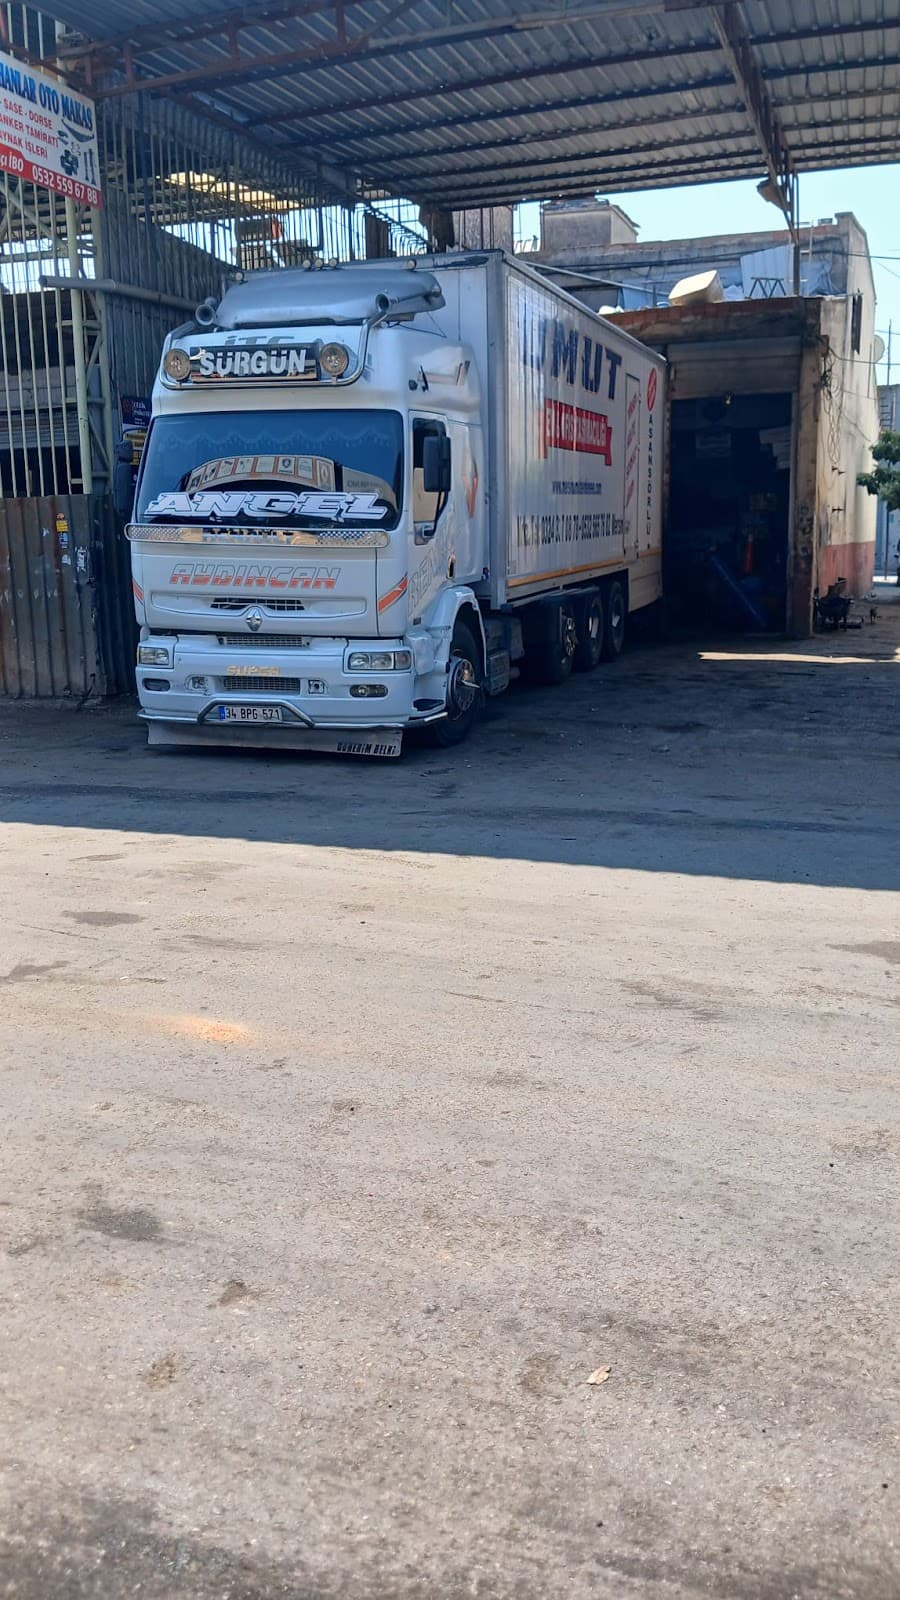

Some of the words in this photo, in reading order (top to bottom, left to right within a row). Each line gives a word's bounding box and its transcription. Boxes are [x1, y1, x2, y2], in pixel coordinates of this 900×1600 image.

[29, 109, 53, 130] DORSE
[39, 82, 59, 115] OTO
[61, 93, 93, 131] MAKAS
[32, 165, 54, 187] 0532
[56, 175, 73, 195] 559
[75, 184, 85, 199] 67
[199, 349, 307, 377] SÜRGÜN
[143, 490, 388, 521] ANGEL
[225, 708, 237, 719] 34
[240, 707, 258, 720] BPG
[262, 708, 280, 721] 571
